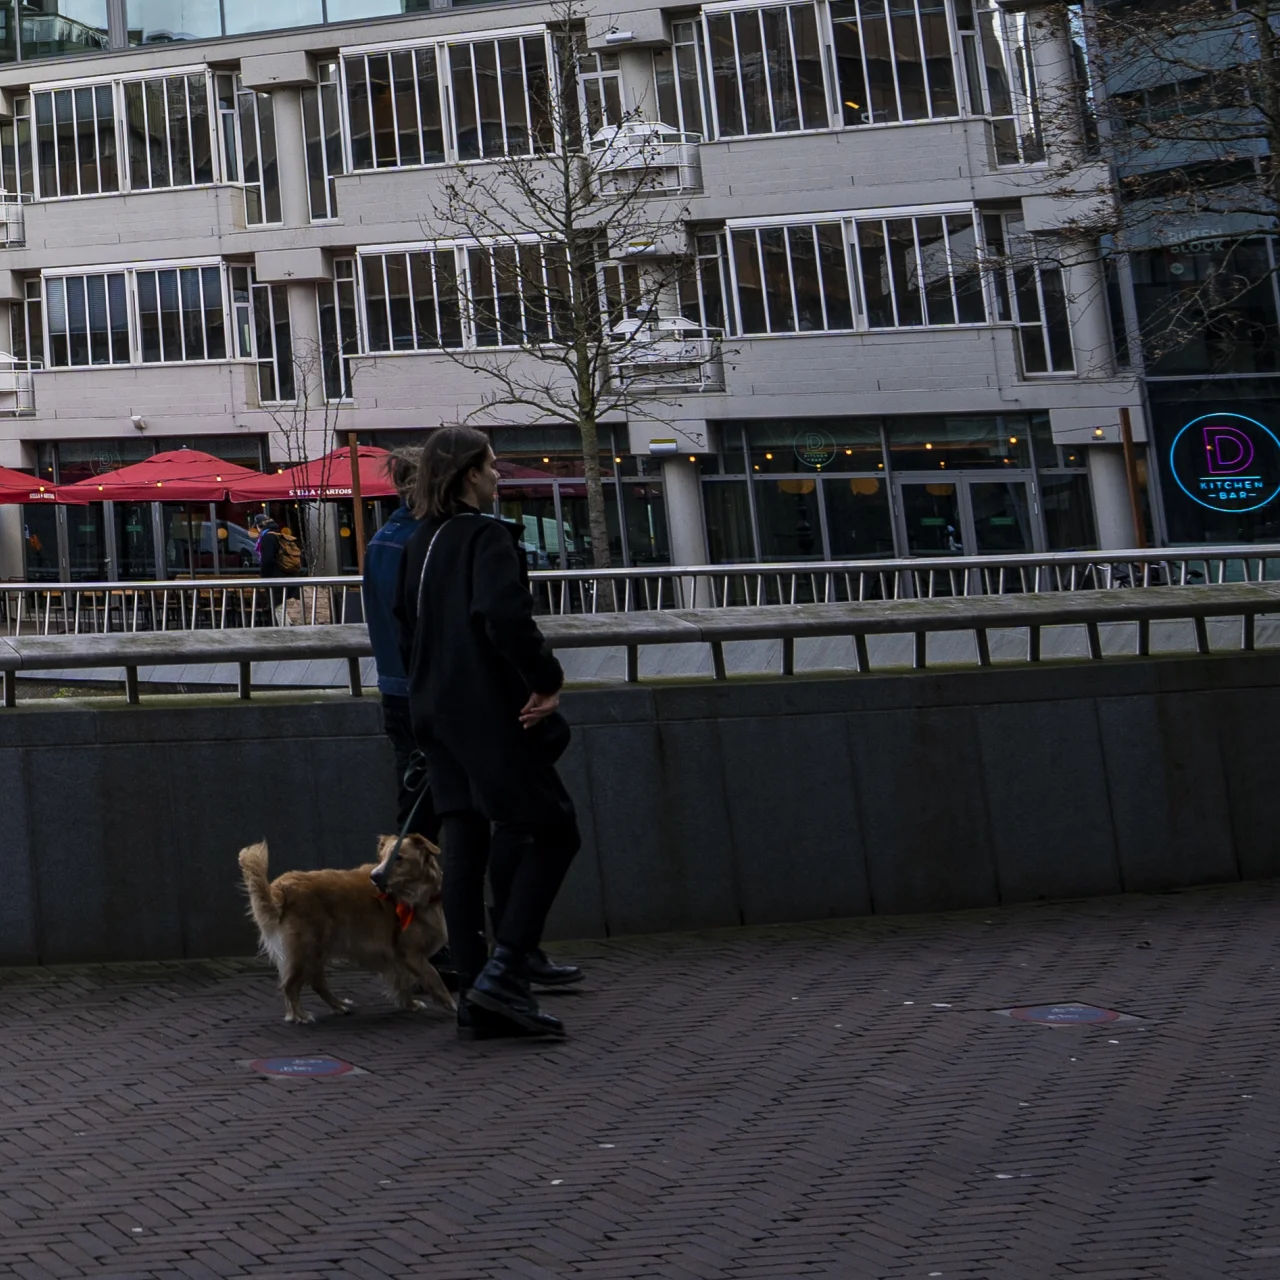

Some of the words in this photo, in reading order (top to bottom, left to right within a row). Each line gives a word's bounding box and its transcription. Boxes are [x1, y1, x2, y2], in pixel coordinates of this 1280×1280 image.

[1170, 240, 1224, 253] BLOCK
[1203, 426, 1254, 474] D
[1200, 480, 1263, 490] KITCHEN
